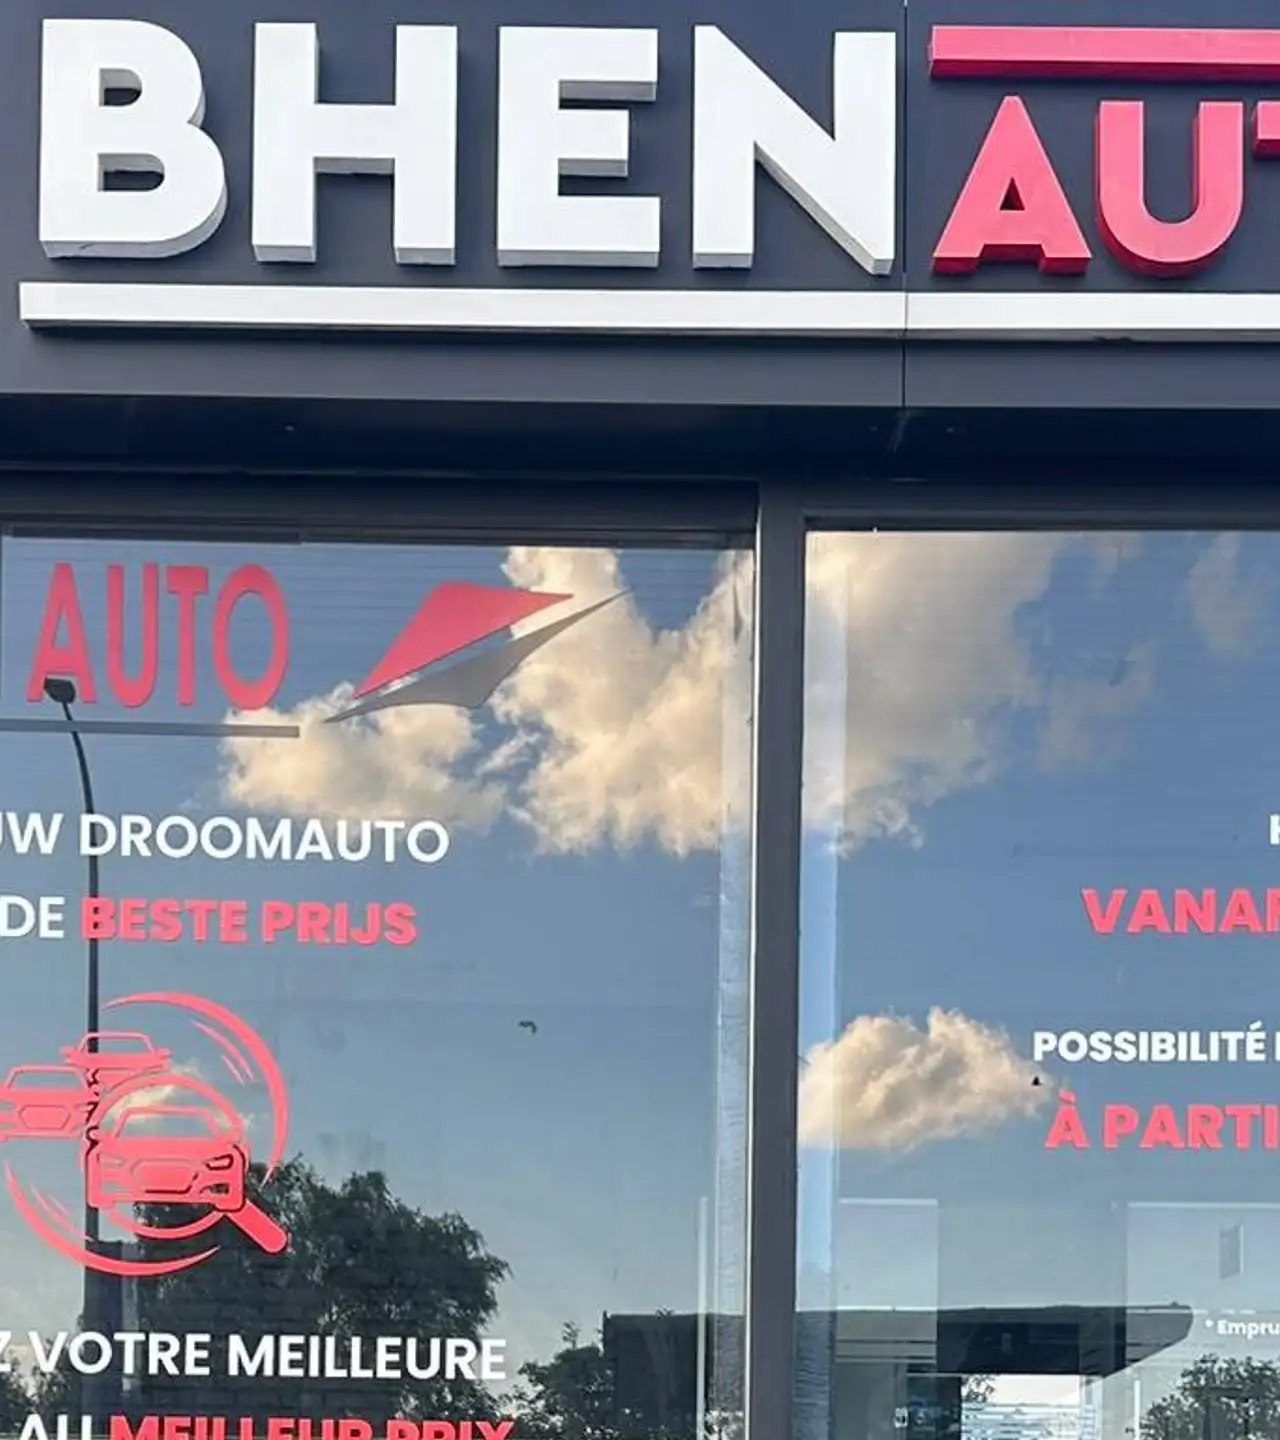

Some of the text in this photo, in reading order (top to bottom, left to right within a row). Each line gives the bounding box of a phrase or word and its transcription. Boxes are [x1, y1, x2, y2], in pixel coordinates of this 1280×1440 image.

[39, 17, 897, 274] BHEN
[25, 561, 291, 711] AUTO
[78, 813, 450, 864] DROOMAUTO
[79, 897, 249, 944] BESTE
[261, 901, 418, 947] PRIJS
[1033, 1020, 1266, 1063] POSSIBILITÉ
[1045, 1091, 1089, 1150] À
[30, 1331, 210, 1377] VOTRE
[229, 1335, 508, 1381] MEILLEURE
